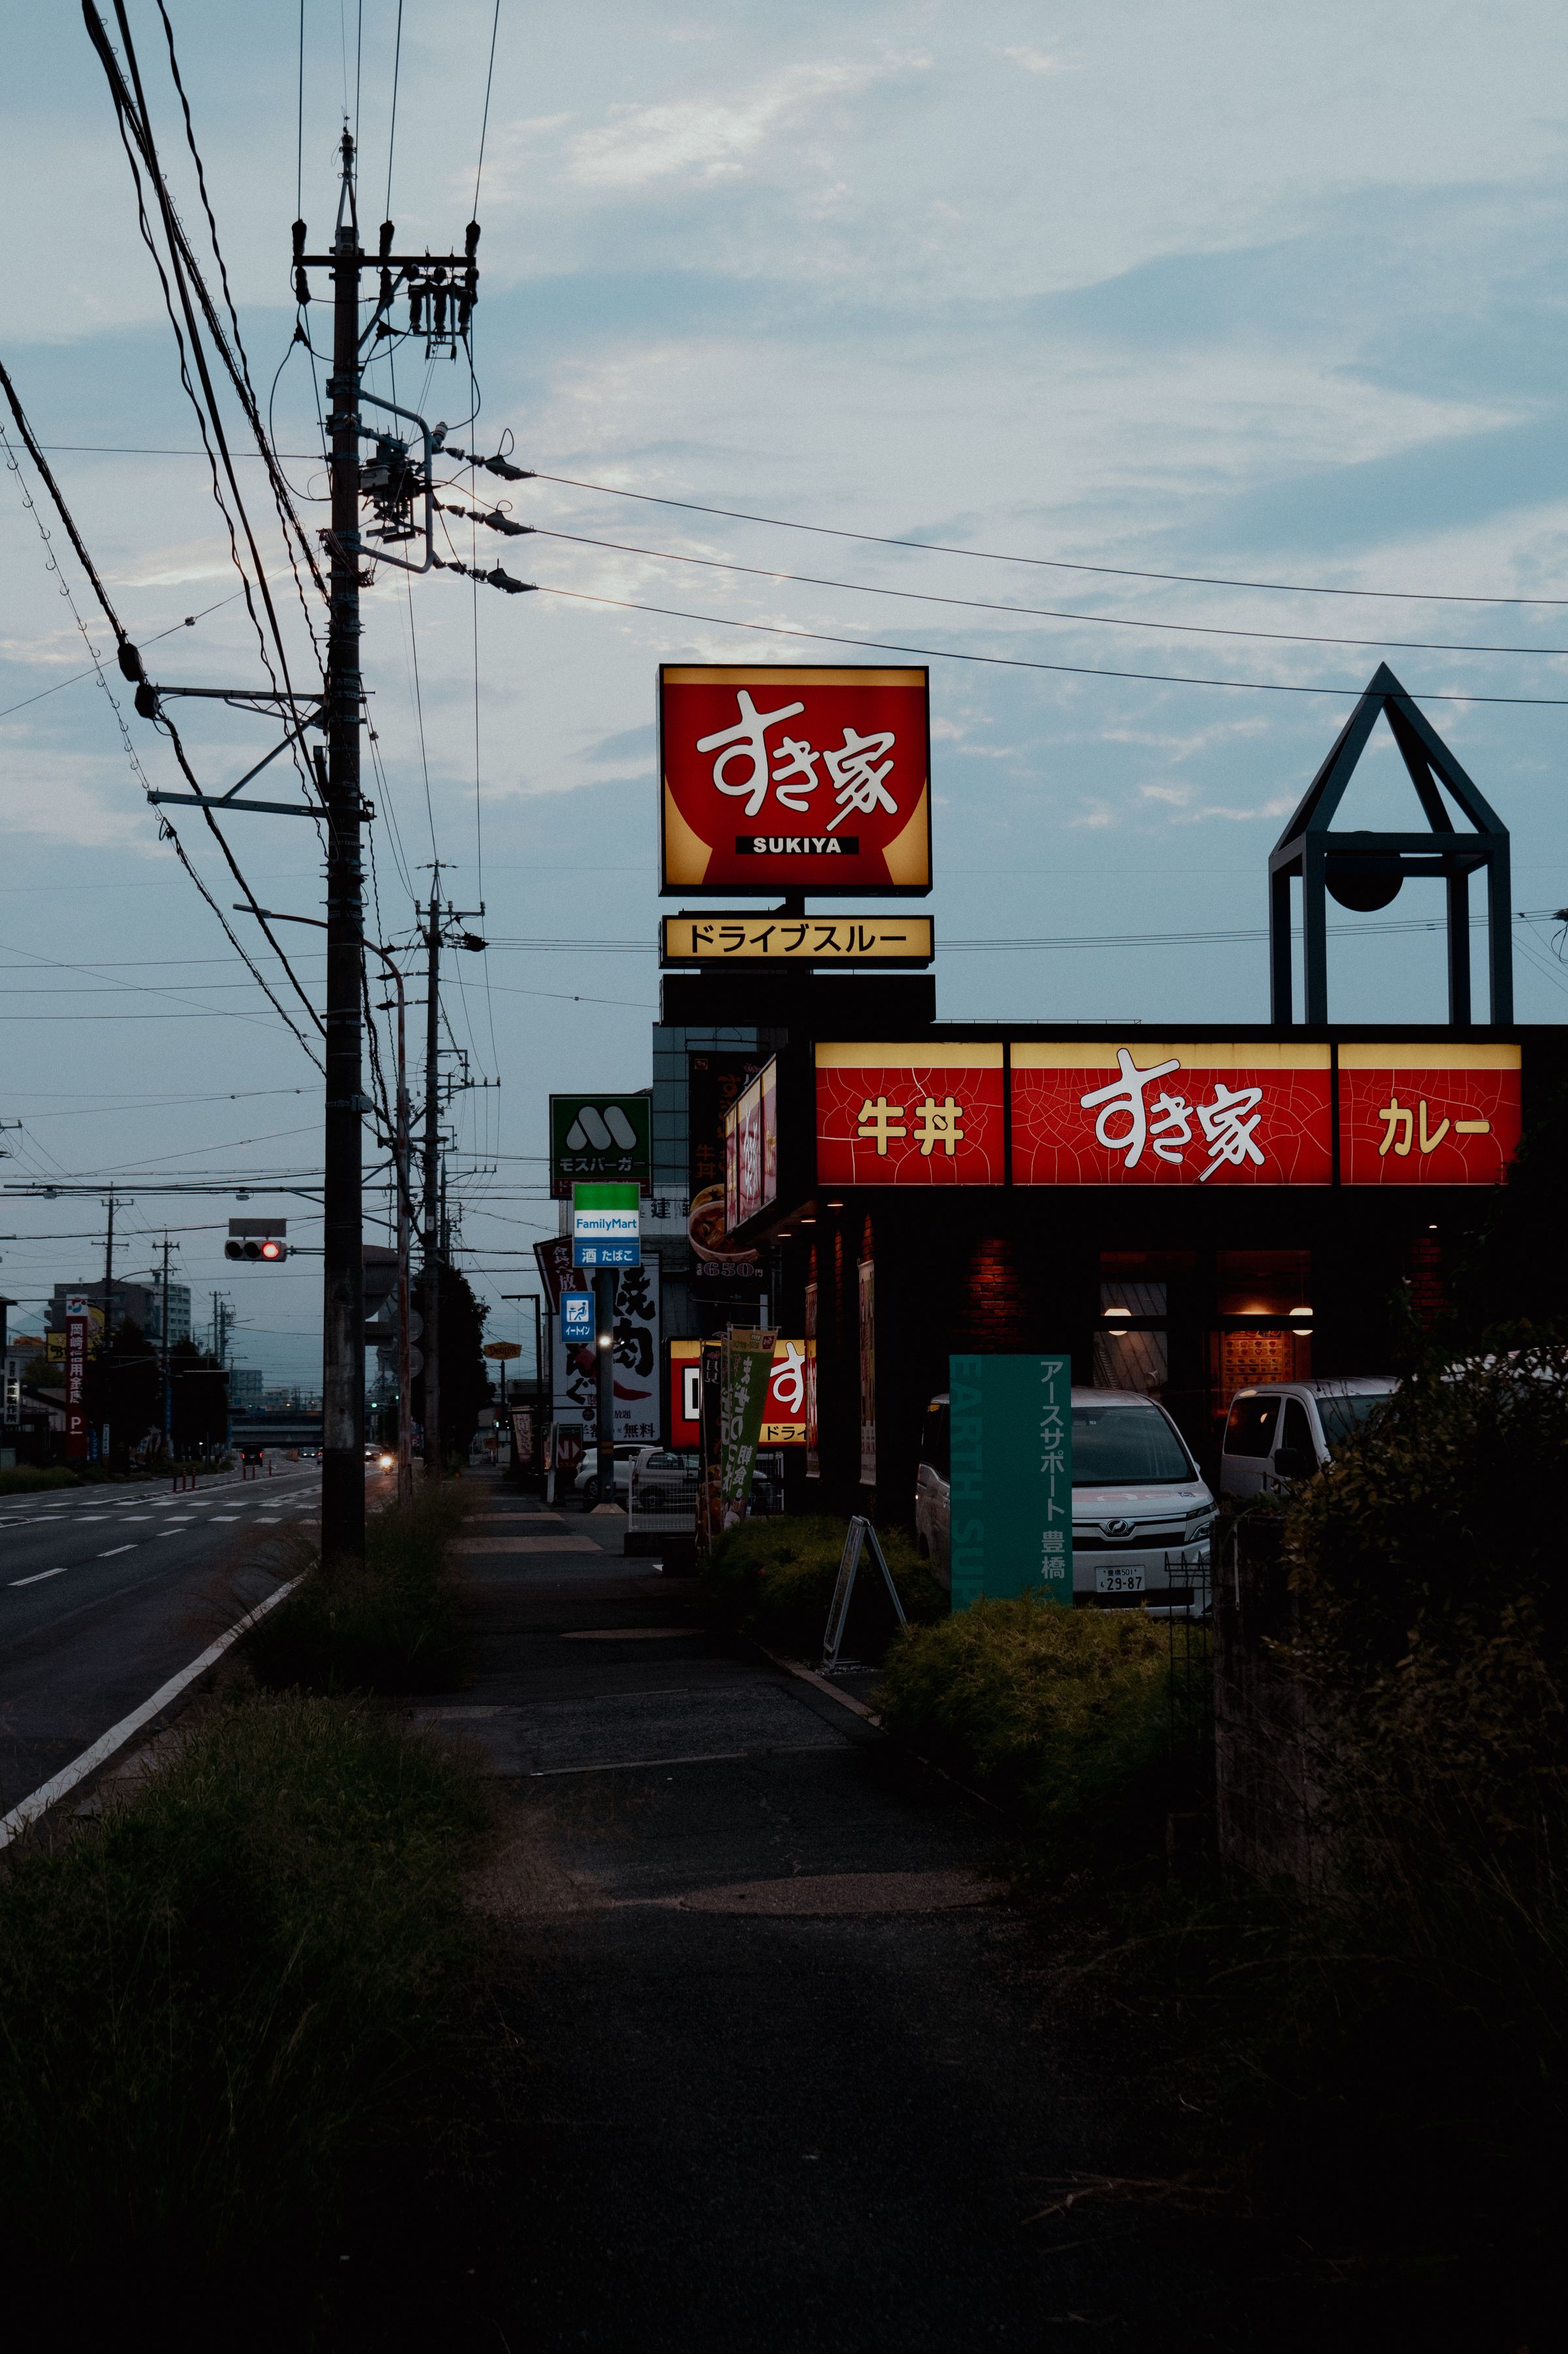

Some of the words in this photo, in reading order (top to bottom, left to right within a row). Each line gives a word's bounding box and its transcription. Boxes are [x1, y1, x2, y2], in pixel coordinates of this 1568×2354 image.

[696, 689, 898, 831] すき家
[753, 837, 842, 854] SUKIYA
[691, 923, 907, 953] ドライブスルー
[857, 1095, 964, 1156] 牛丼
[1080, 1048, 1266, 1182] すき家
[1378, 1097, 1491, 1155] カレー
[559, 1156, 646, 1172] モスバーガー
[694, 1144, 717, 1180] 牛丼
[576, 1218, 637, 1231] FamilyMart
[581, 1248, 597, 1263] 酒
[602, 1250, 633, 1262] たばこ
[566, 1325, 591, 1336] イートイン
[71, 1417, 82, 1429] P
[623, 1423, 655, 1438] 無料
[1040, 1361, 1065, 1521] アースサポート
[1041, 1531, 1066, 1580] 豊橋
[1107, 1576, 1142, 1591] 29-87
